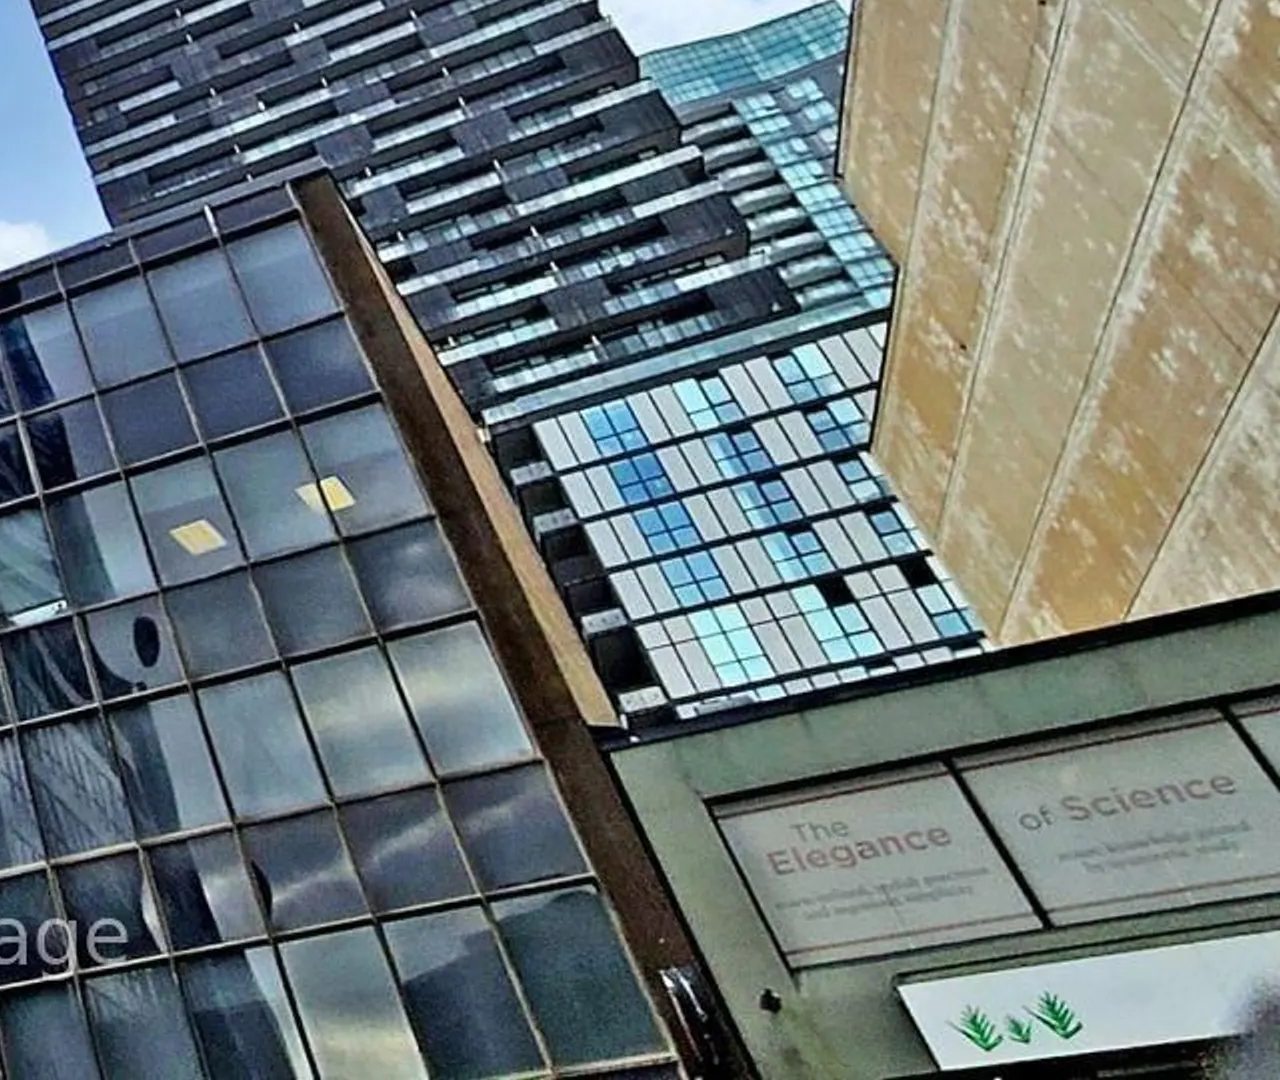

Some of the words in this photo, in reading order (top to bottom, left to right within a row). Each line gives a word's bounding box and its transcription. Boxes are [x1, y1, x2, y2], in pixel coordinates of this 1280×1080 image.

[1019, 805, 1054, 831] of
[1061, 775, 1237, 821] Science
[766, 827, 952, 876] Elegance
[791, 821, 849, 843] The
